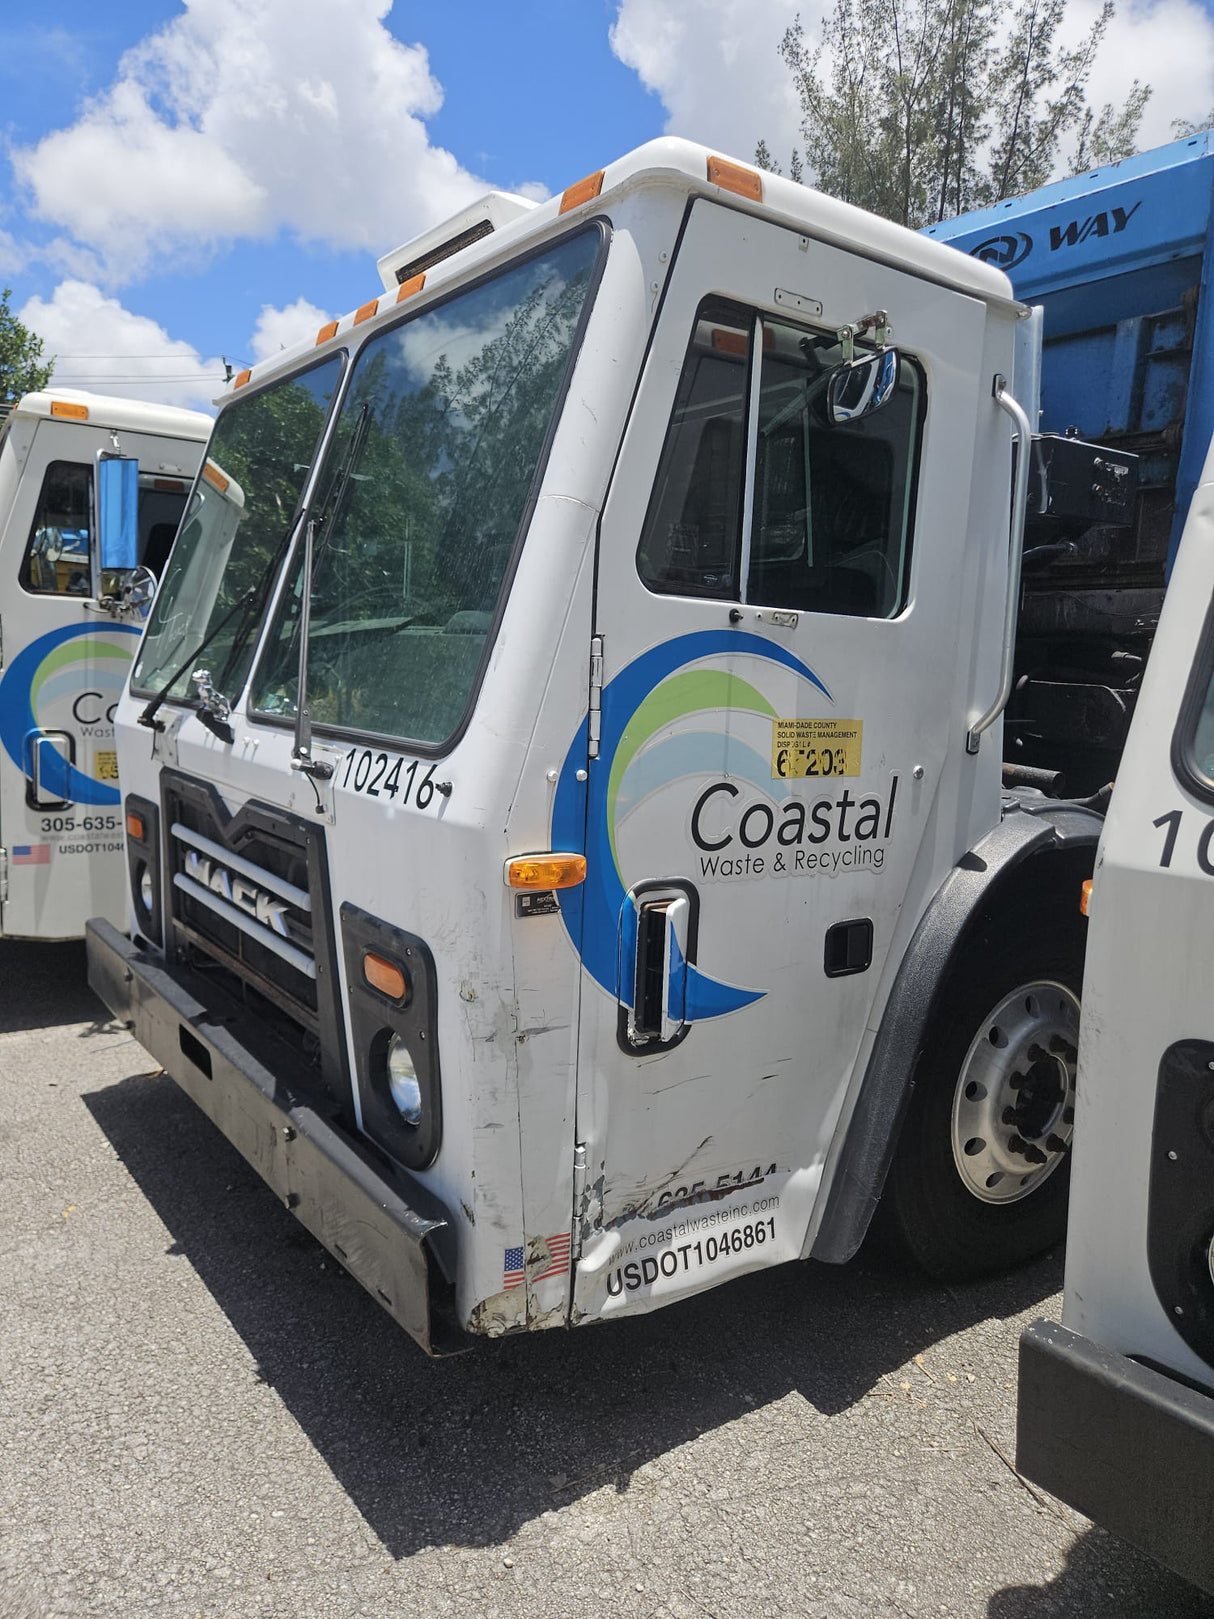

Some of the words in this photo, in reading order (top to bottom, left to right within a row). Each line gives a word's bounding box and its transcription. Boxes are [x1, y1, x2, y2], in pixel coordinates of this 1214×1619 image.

[1050, 201, 1143, 251] WAY
[777, 721, 812, 729] MIAMI-DADE
[813, 721, 837, 729] COUNTY
[777, 731, 795, 739] SOLID
[796, 731, 816, 739] WASTE
[817, 731, 857, 739] MANAGEMENT
[343, 747, 438, 810] 102416
[691, 775, 899, 852] Coastal
[59, 843, 124, 854] USDOT104
[700, 854, 765, 878] Waste
[773, 851, 787, 873] &
[794, 845, 885, 873] Recycling
[185, 850, 291, 938] MACK
[606, 1216, 776, 1298] USDOT1046861
[608, 1195, 780, 1266] www.coastalwasteinc.com
